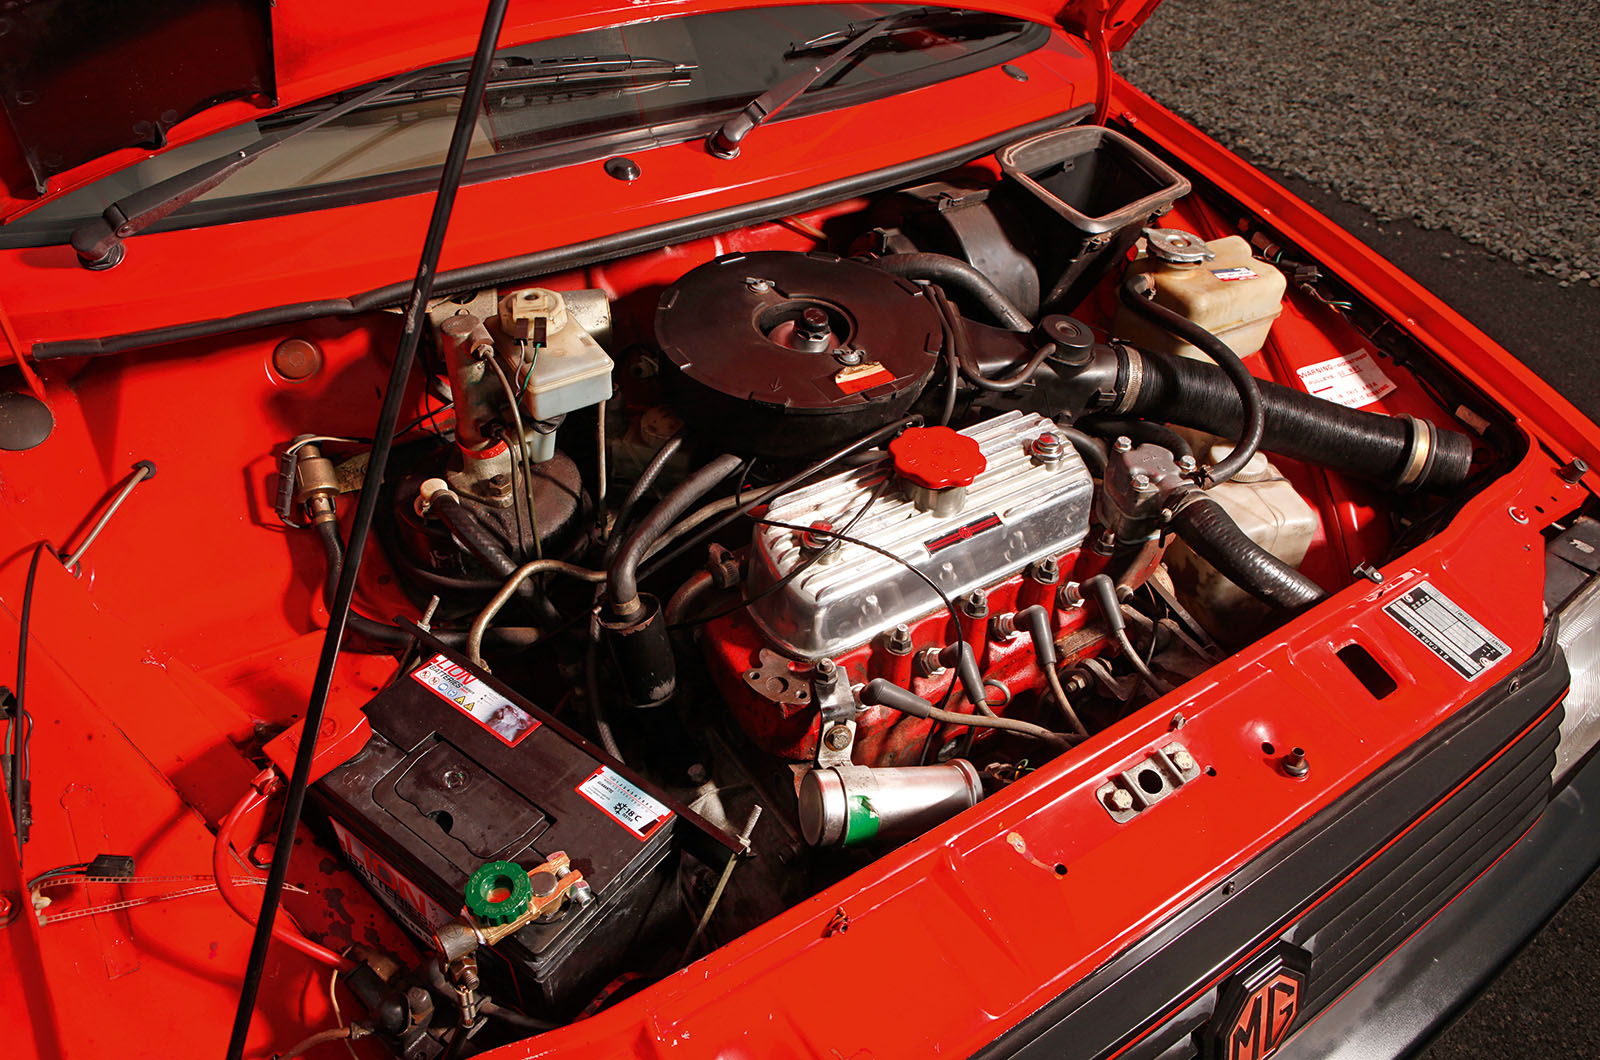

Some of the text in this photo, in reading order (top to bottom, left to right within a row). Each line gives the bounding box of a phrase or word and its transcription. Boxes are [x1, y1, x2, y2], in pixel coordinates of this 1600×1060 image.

[1298, 364, 1332, 378] WARNING
[1420, 635, 1438, 650] CARS
[428, 663, 463, 689] BATTERIES
[436, 658, 478, 685] LION
[1234, 981, 1294, 1060] MG
